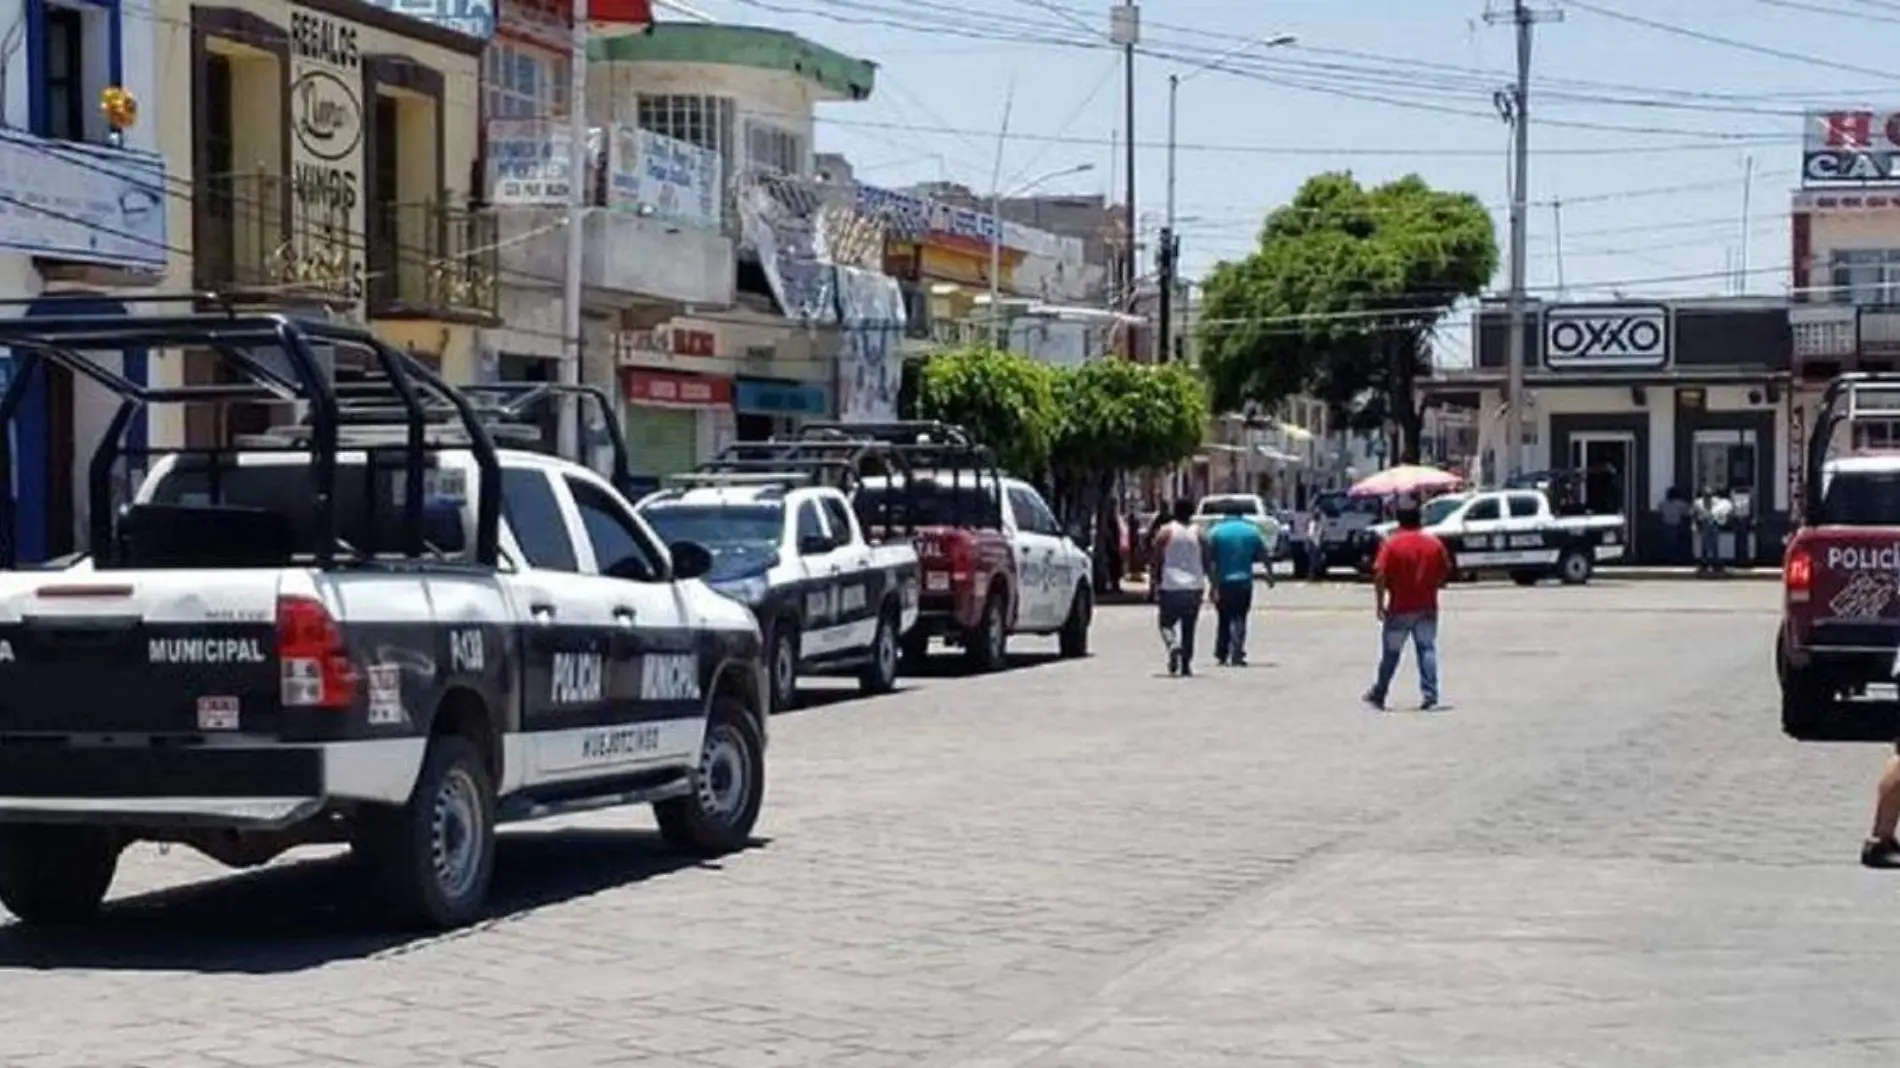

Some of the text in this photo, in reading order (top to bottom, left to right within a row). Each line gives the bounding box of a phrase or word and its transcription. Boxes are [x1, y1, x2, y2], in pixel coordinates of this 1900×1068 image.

[291, 11, 357, 67] REGALOS
[292, 163, 357, 209] VINOS
[1552, 317, 1660, 356] OXXO
[149, 638, 266, 662] MUNICIPAL
[640, 653, 701, 700] MUNICIPAL
